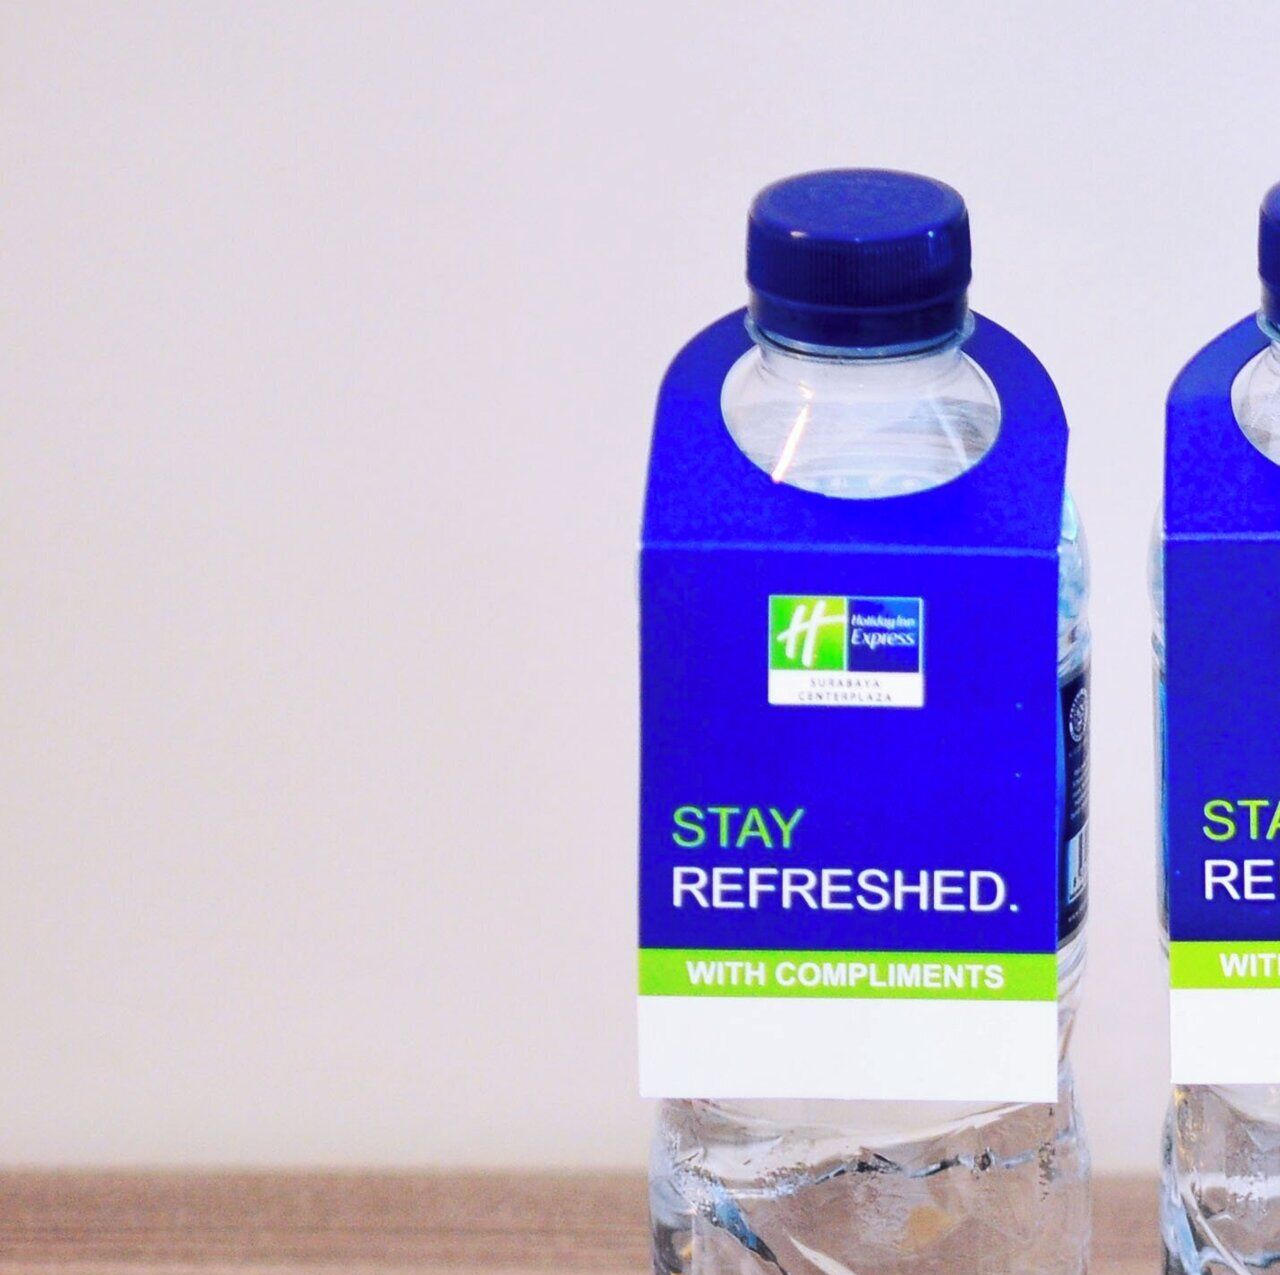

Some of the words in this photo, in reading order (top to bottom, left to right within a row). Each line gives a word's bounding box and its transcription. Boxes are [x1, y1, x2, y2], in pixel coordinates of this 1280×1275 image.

[851, 629, 915, 650] Express
[810, 678, 880, 687] SURABAYA
[798, 691, 892, 701] CENTERPLAZA
[672, 807, 805, 848] STAY
[671, 866, 1019, 912] REFRESHED.
[687, 960, 765, 987] WITH
[775, 961, 1004, 988] COMPLIMENTS
